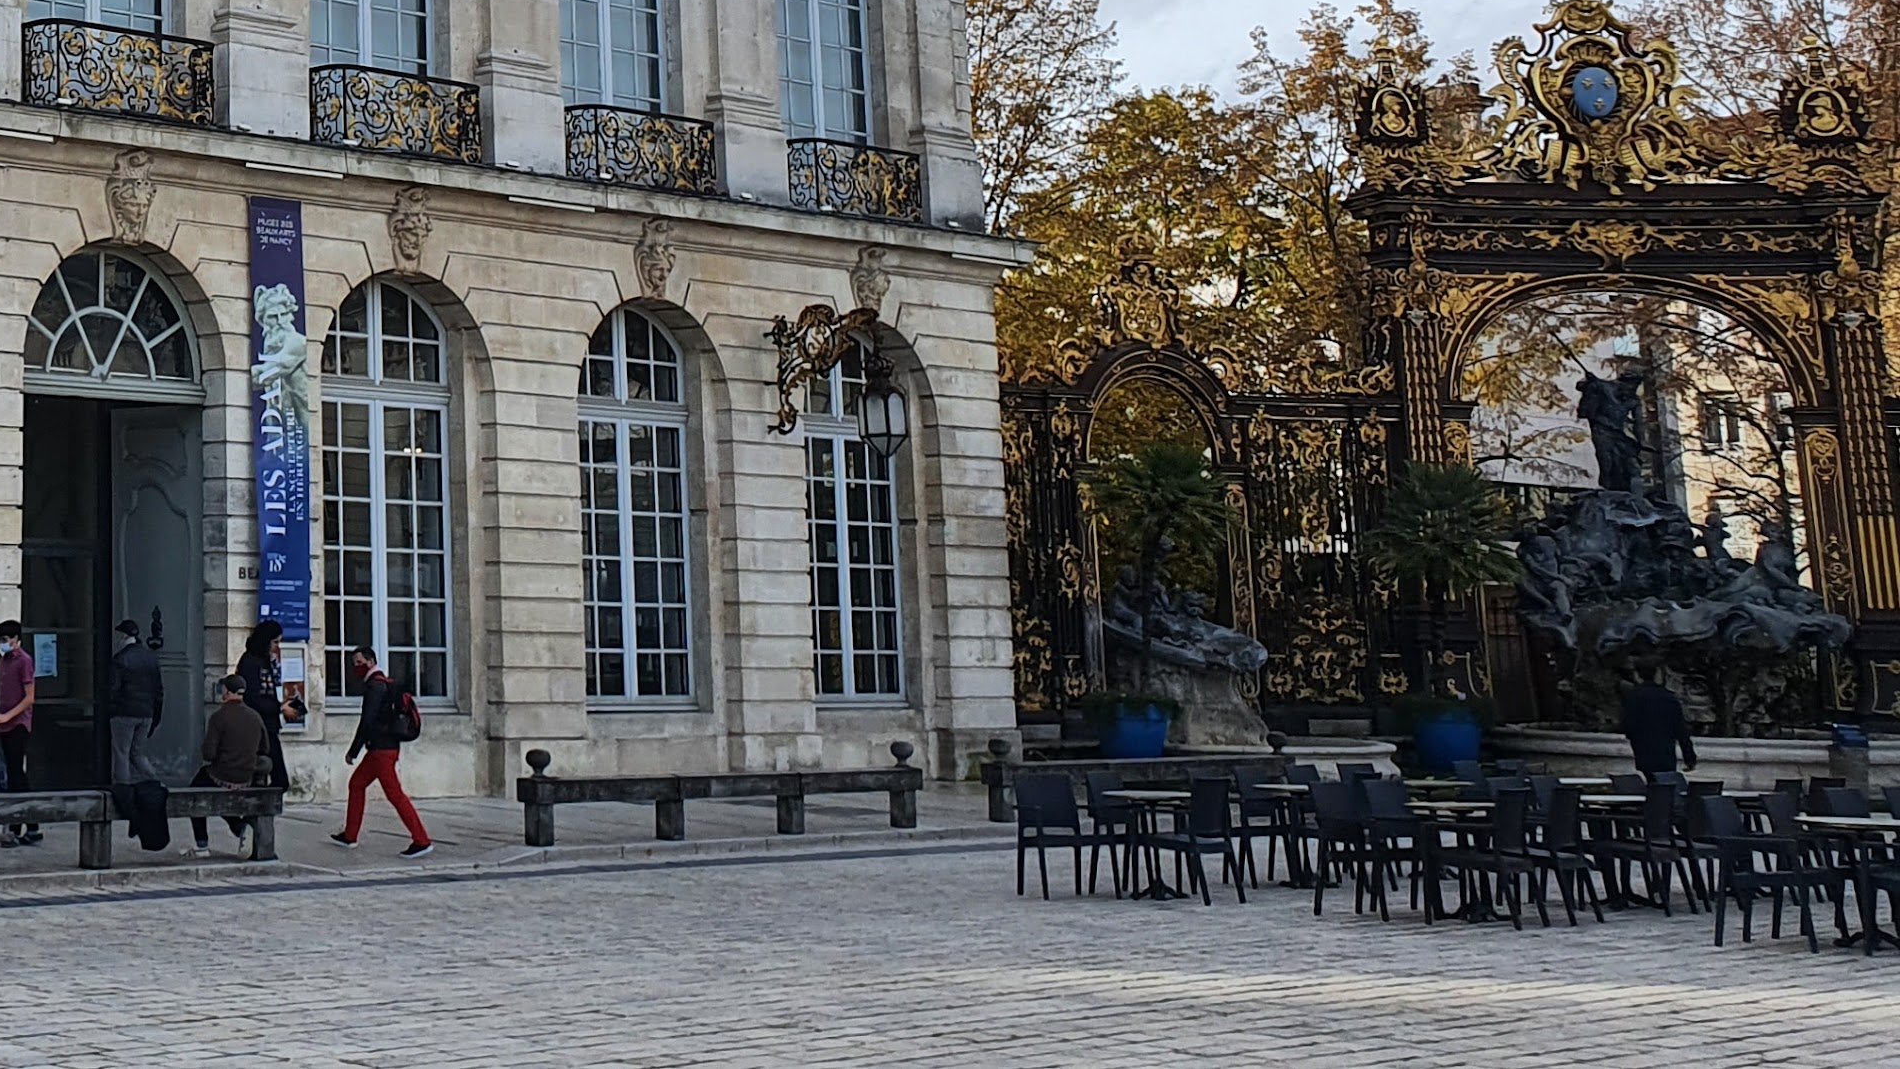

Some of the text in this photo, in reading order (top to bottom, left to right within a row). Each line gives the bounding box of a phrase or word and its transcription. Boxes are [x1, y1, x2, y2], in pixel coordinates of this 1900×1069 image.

[269, 236, 292, 245] NANCY
[285, 407, 296, 492] SCULPTURE
[262, 469, 287, 536] LES
[296, 501, 304, 521] EN
